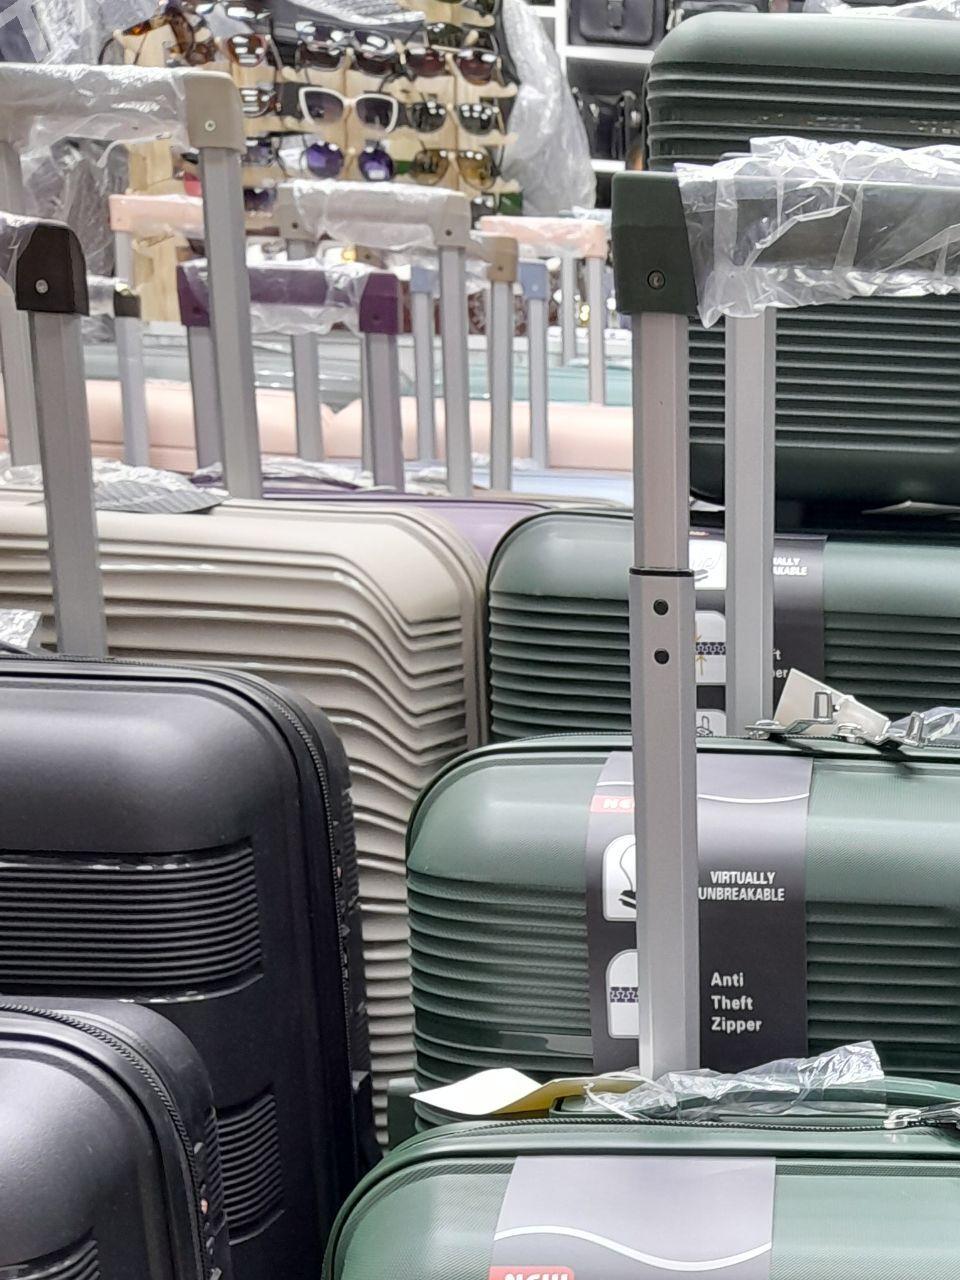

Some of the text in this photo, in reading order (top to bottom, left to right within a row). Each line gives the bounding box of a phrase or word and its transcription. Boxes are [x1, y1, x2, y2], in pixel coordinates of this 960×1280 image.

[603, 798, 635, 809] NE
[710, 871, 776, 885] VIRTUALLY
[698, 887, 785, 901] UNBREAKABLE
[711, 972, 744, 987] Anti
[711, 996, 753, 1010] Theft
[711, 1017, 762, 1034] Zipper
